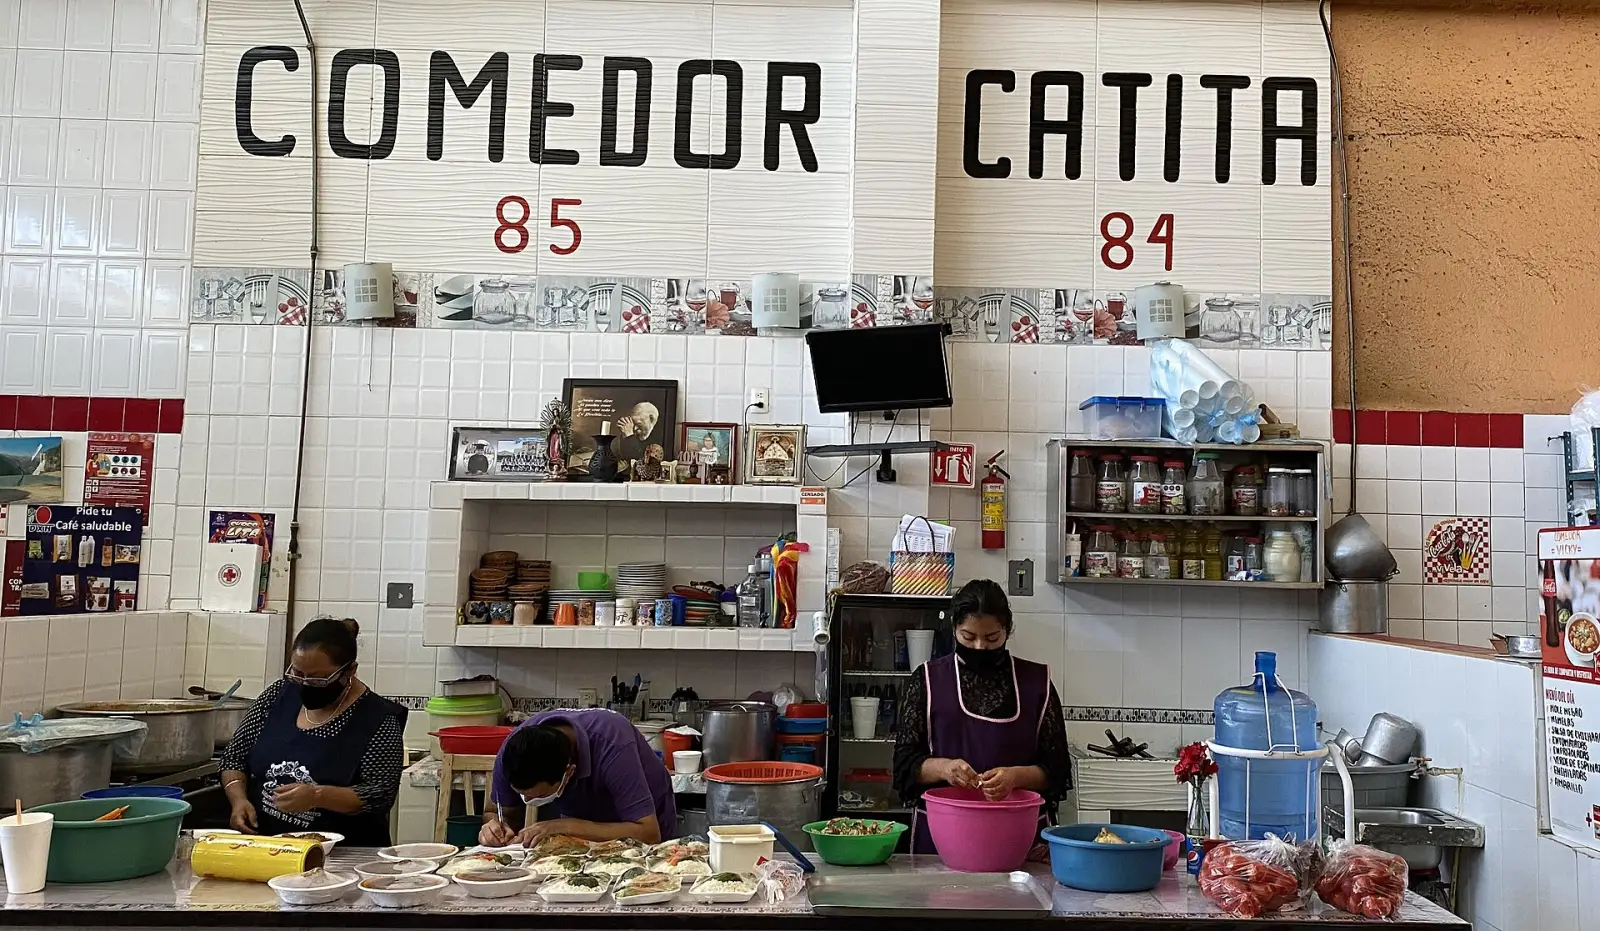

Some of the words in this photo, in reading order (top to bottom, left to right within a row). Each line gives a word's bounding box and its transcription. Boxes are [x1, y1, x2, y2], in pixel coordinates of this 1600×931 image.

[236, 46, 821, 172] COMEDOR
[963, 69, 1318, 186] CATITA
[495, 196, 582, 255] 85
[1100, 213, 1175, 270] 84
[55, 520, 79, 530] Café
[81, 521, 132, 532] saludable
[76, 507, 98, 516] Pide
[101, 508, 112, 516] tu
[1550, 705, 1563, 715] MOLE
[1564, 707, 1583, 718] NEGRO
